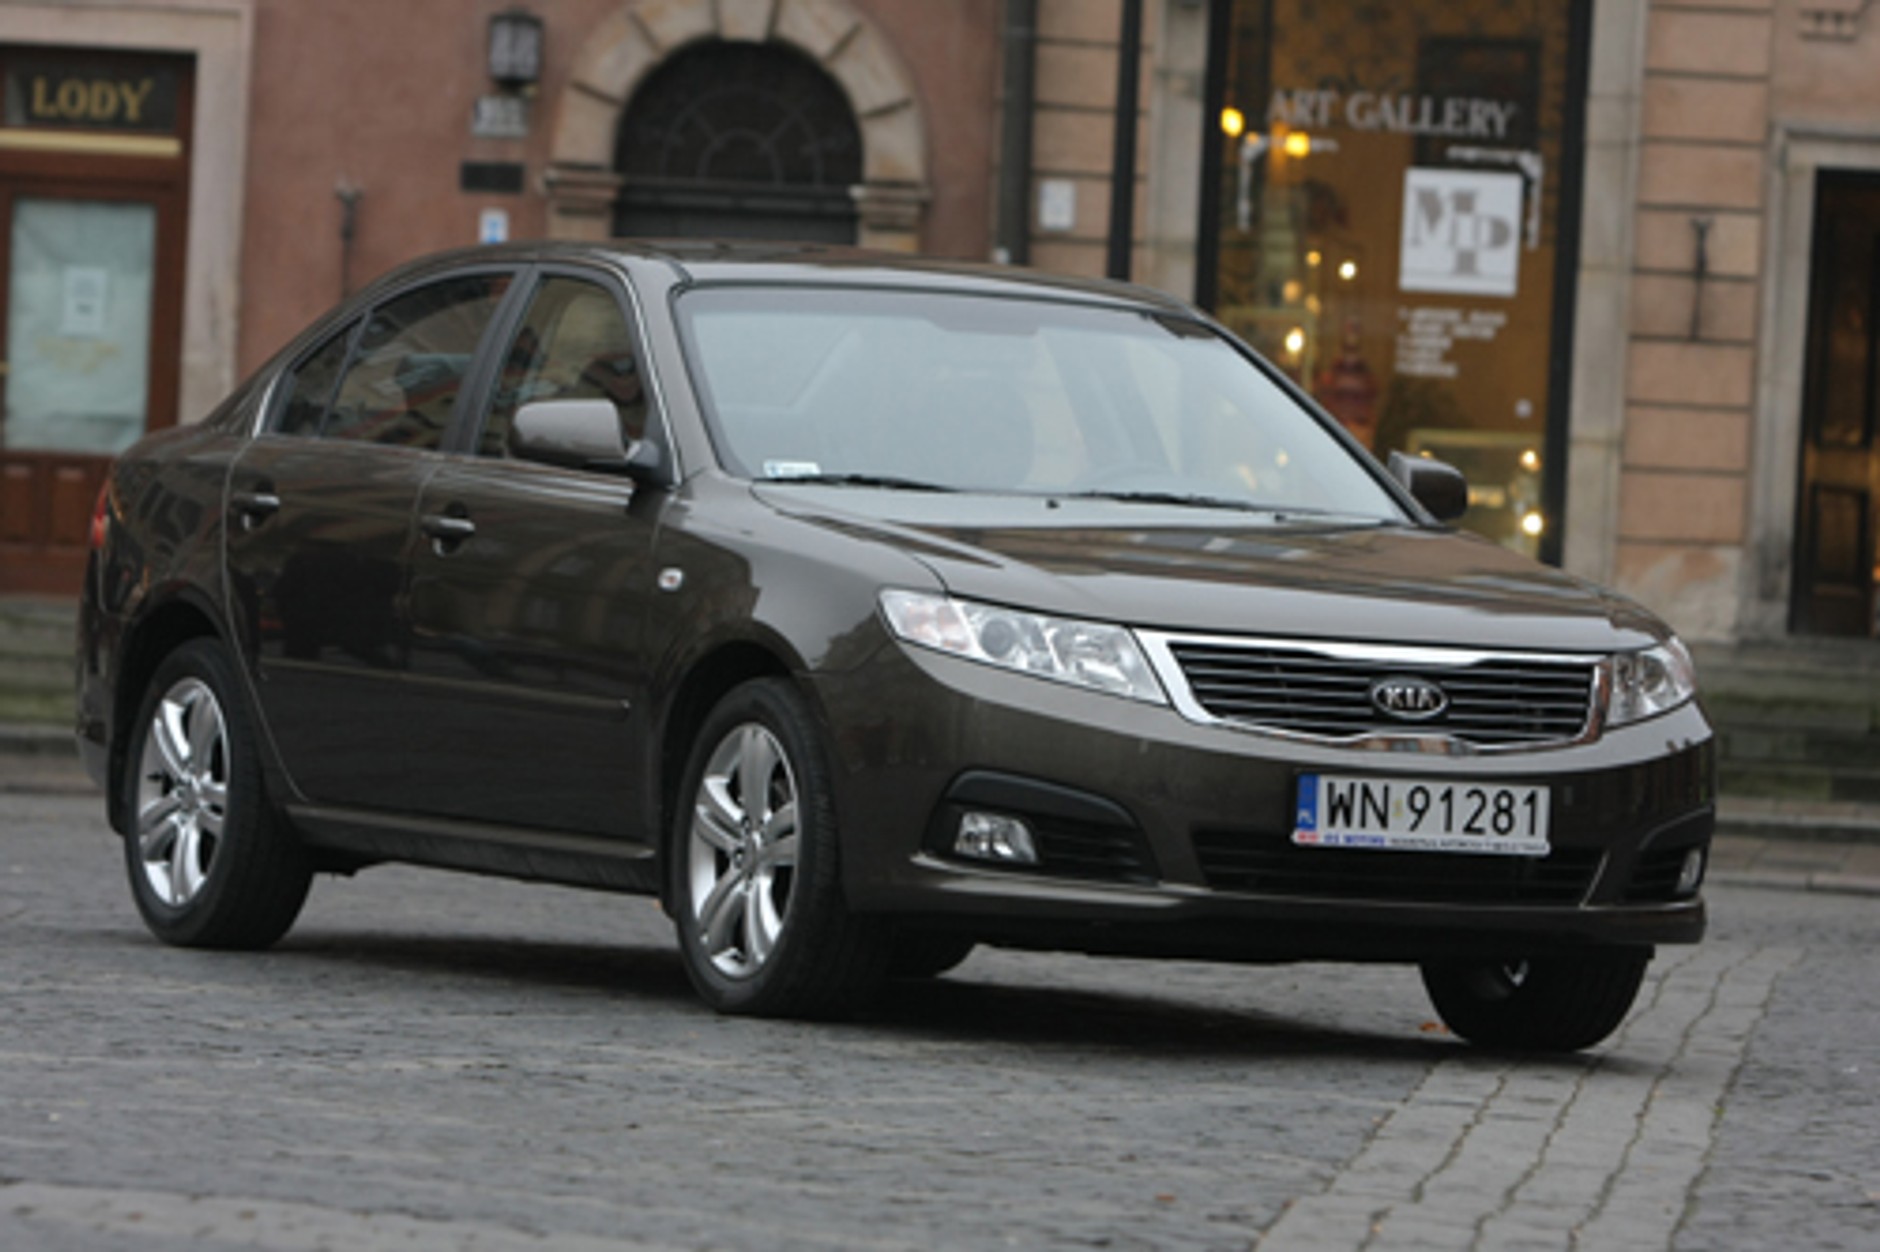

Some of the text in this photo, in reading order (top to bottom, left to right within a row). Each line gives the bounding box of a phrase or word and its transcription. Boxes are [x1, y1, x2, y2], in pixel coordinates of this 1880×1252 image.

[32, 77, 152, 121] LODY
[1267, 90, 1514, 137] ART GALLERY
[1385, 687, 1436, 710] KIA
[1326, 781, 1538, 836] WN 91281
